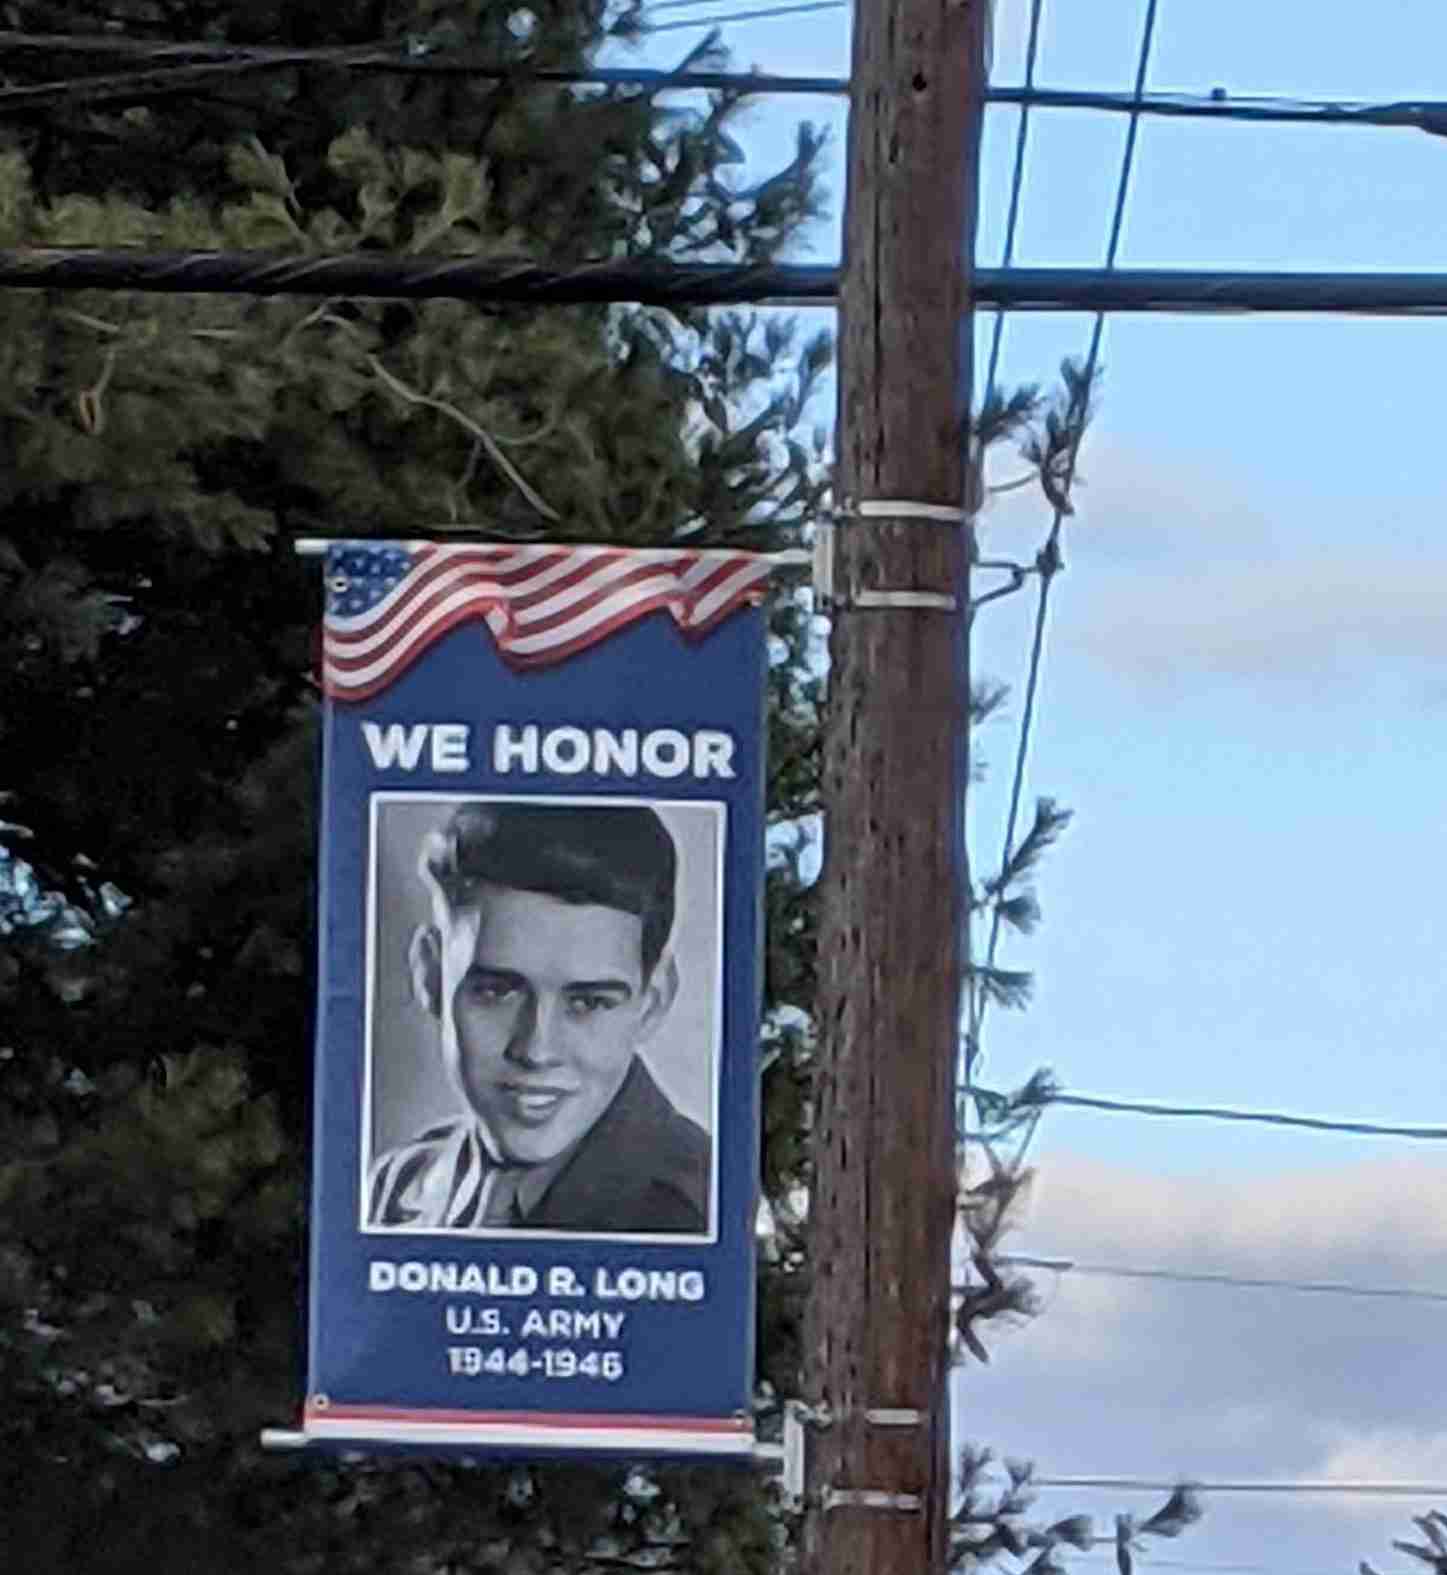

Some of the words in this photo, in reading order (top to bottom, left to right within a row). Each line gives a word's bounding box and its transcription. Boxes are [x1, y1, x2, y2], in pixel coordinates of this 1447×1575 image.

[361, 722, 470, 772] WE
[493, 724, 736, 778] HONOR
[368, 1261, 538, 1296] DONALD
[548, 1266, 586, 1297] R.
[595, 1267, 705, 1301] LONG
[447, 1306, 510, 1335] U.S.
[521, 1309, 624, 1339] ARMY
[447, 1346, 623, 1380] 1944-1946
